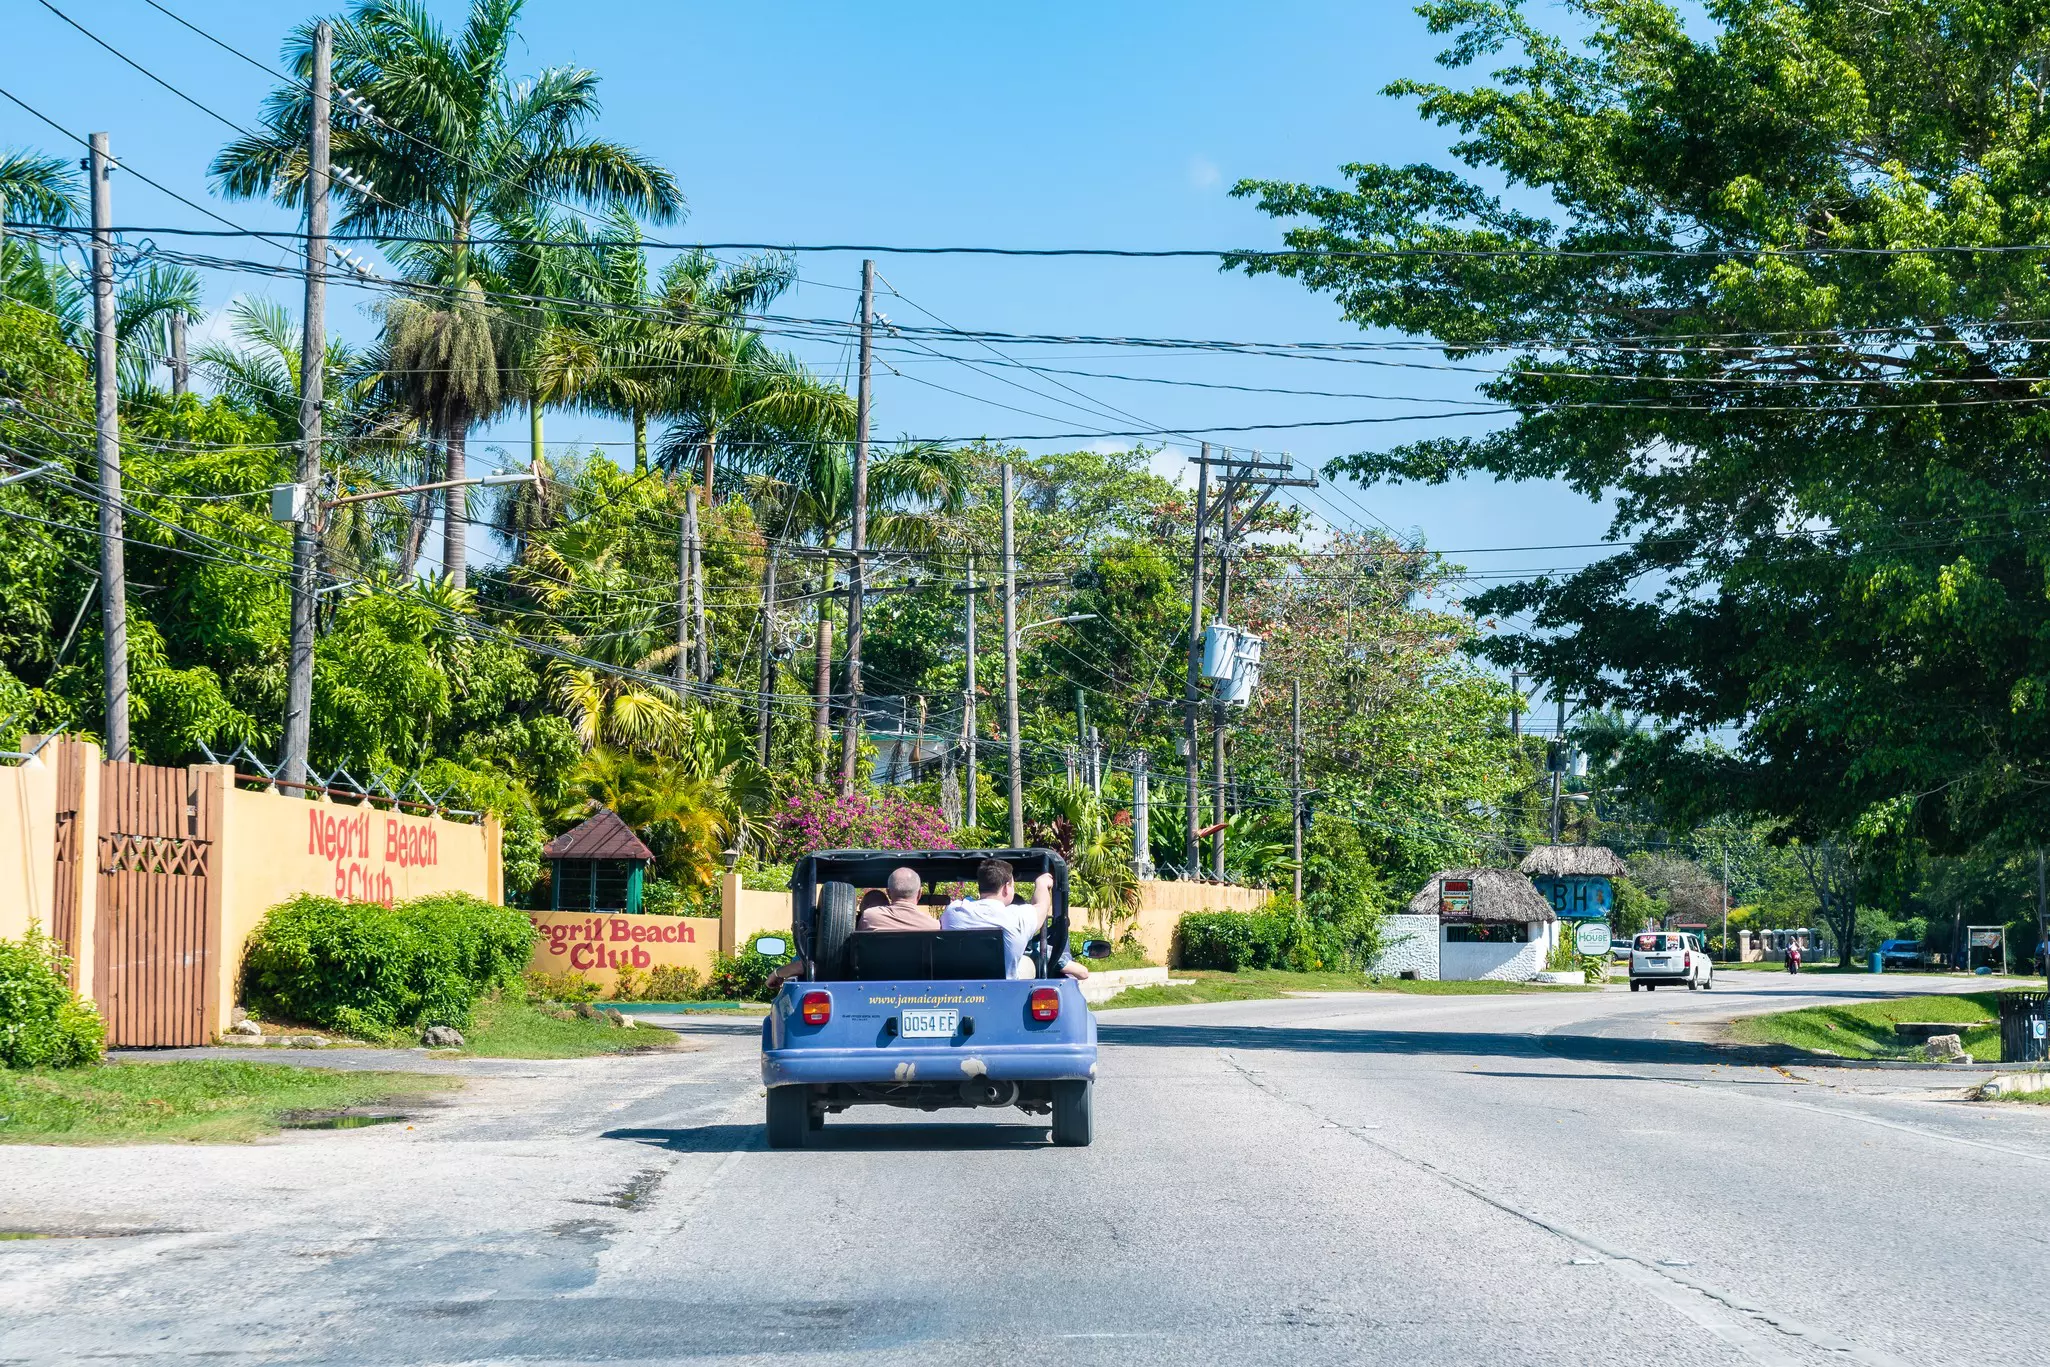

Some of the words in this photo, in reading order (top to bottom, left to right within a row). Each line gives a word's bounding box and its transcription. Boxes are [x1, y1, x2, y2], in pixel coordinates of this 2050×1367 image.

[309, 808, 369, 898] Negril
[386, 819, 437, 868] Beach
[348, 862, 393, 909] Club
[531, 918, 603, 955] egril
[610, 919, 695, 943] Beach
[570, 943, 651, 970] Club
[869, 994, 985, 1008] www.jamaicapirat.com
[904, 1016, 936, 1032] 0054
[939, 1016, 956, 1032] EE
